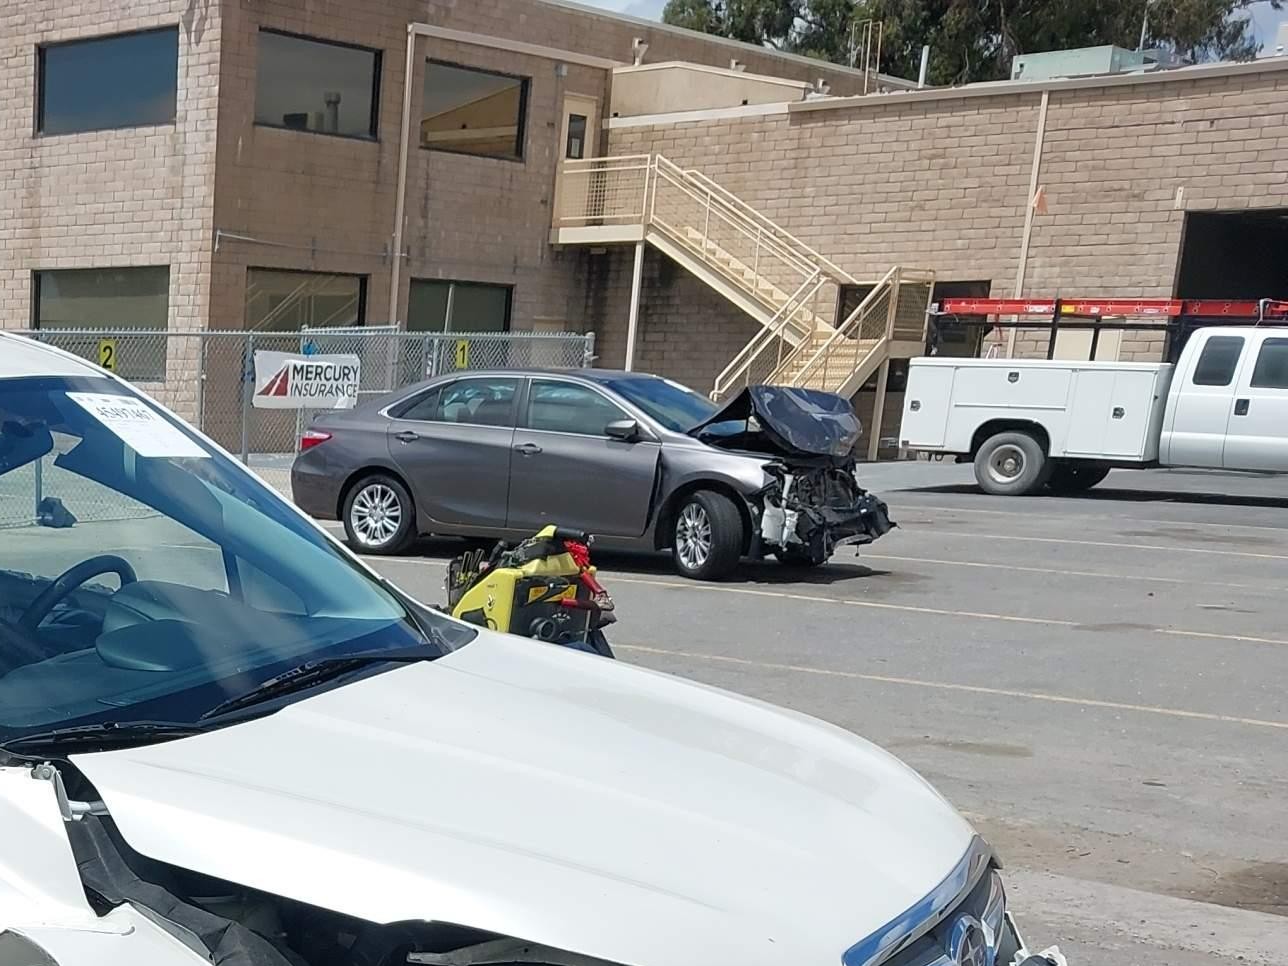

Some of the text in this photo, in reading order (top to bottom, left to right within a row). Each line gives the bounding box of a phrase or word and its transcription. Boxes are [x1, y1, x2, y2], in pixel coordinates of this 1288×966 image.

[102, 345, 113, 369] 2
[459, 344, 465, 364] 1
[292, 364, 359, 383] MERCURY
[290, 383, 357, 398] INSURANCE
